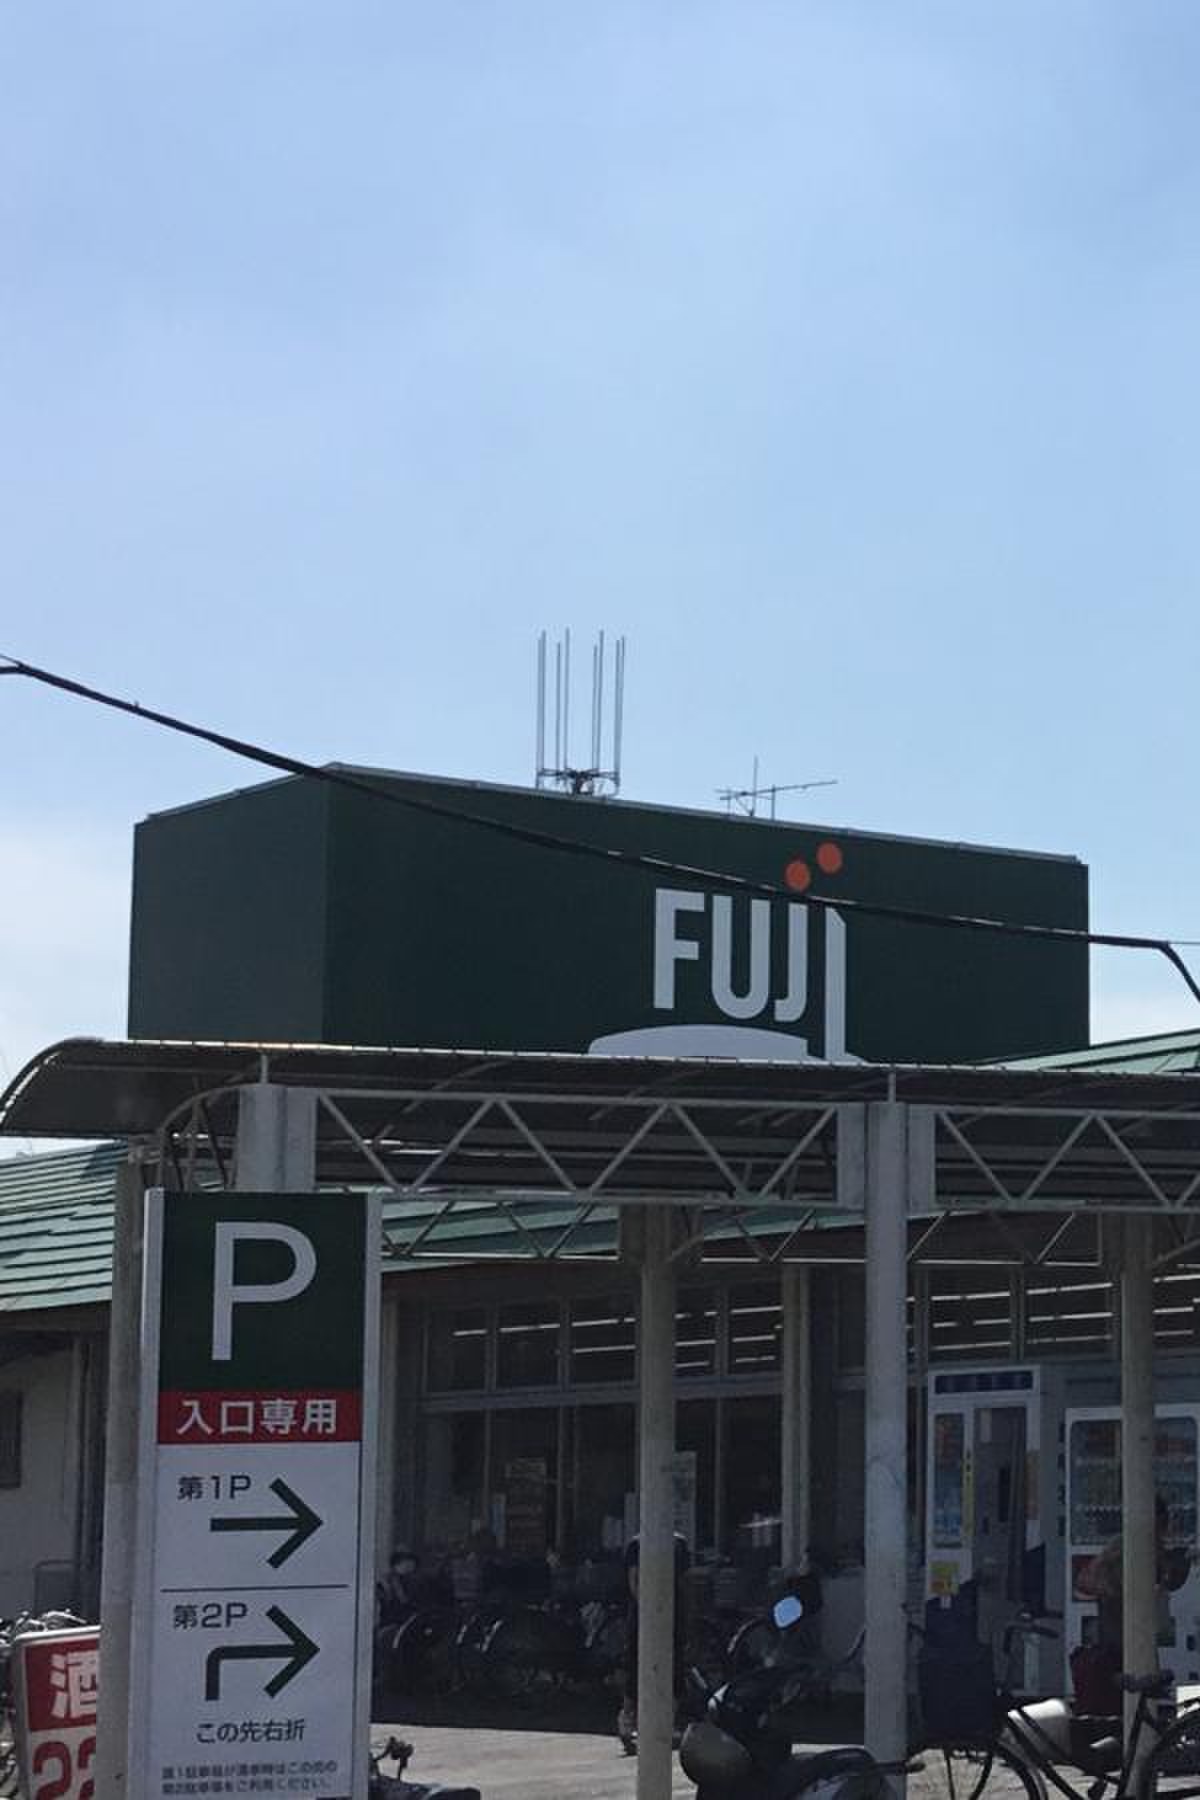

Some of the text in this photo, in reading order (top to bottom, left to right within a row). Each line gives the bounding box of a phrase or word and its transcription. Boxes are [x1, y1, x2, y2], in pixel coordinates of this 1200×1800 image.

[654, 844, 848, 1062] FUJI
[211, 1221, 317, 1361] P
[176, 1398, 338, 1436] 入口専用
[176, 1475, 252, 1501] 第1P
[172, 1604, 248, 1630] 第2P
[196, 1718, 305, 1744] この先右折
